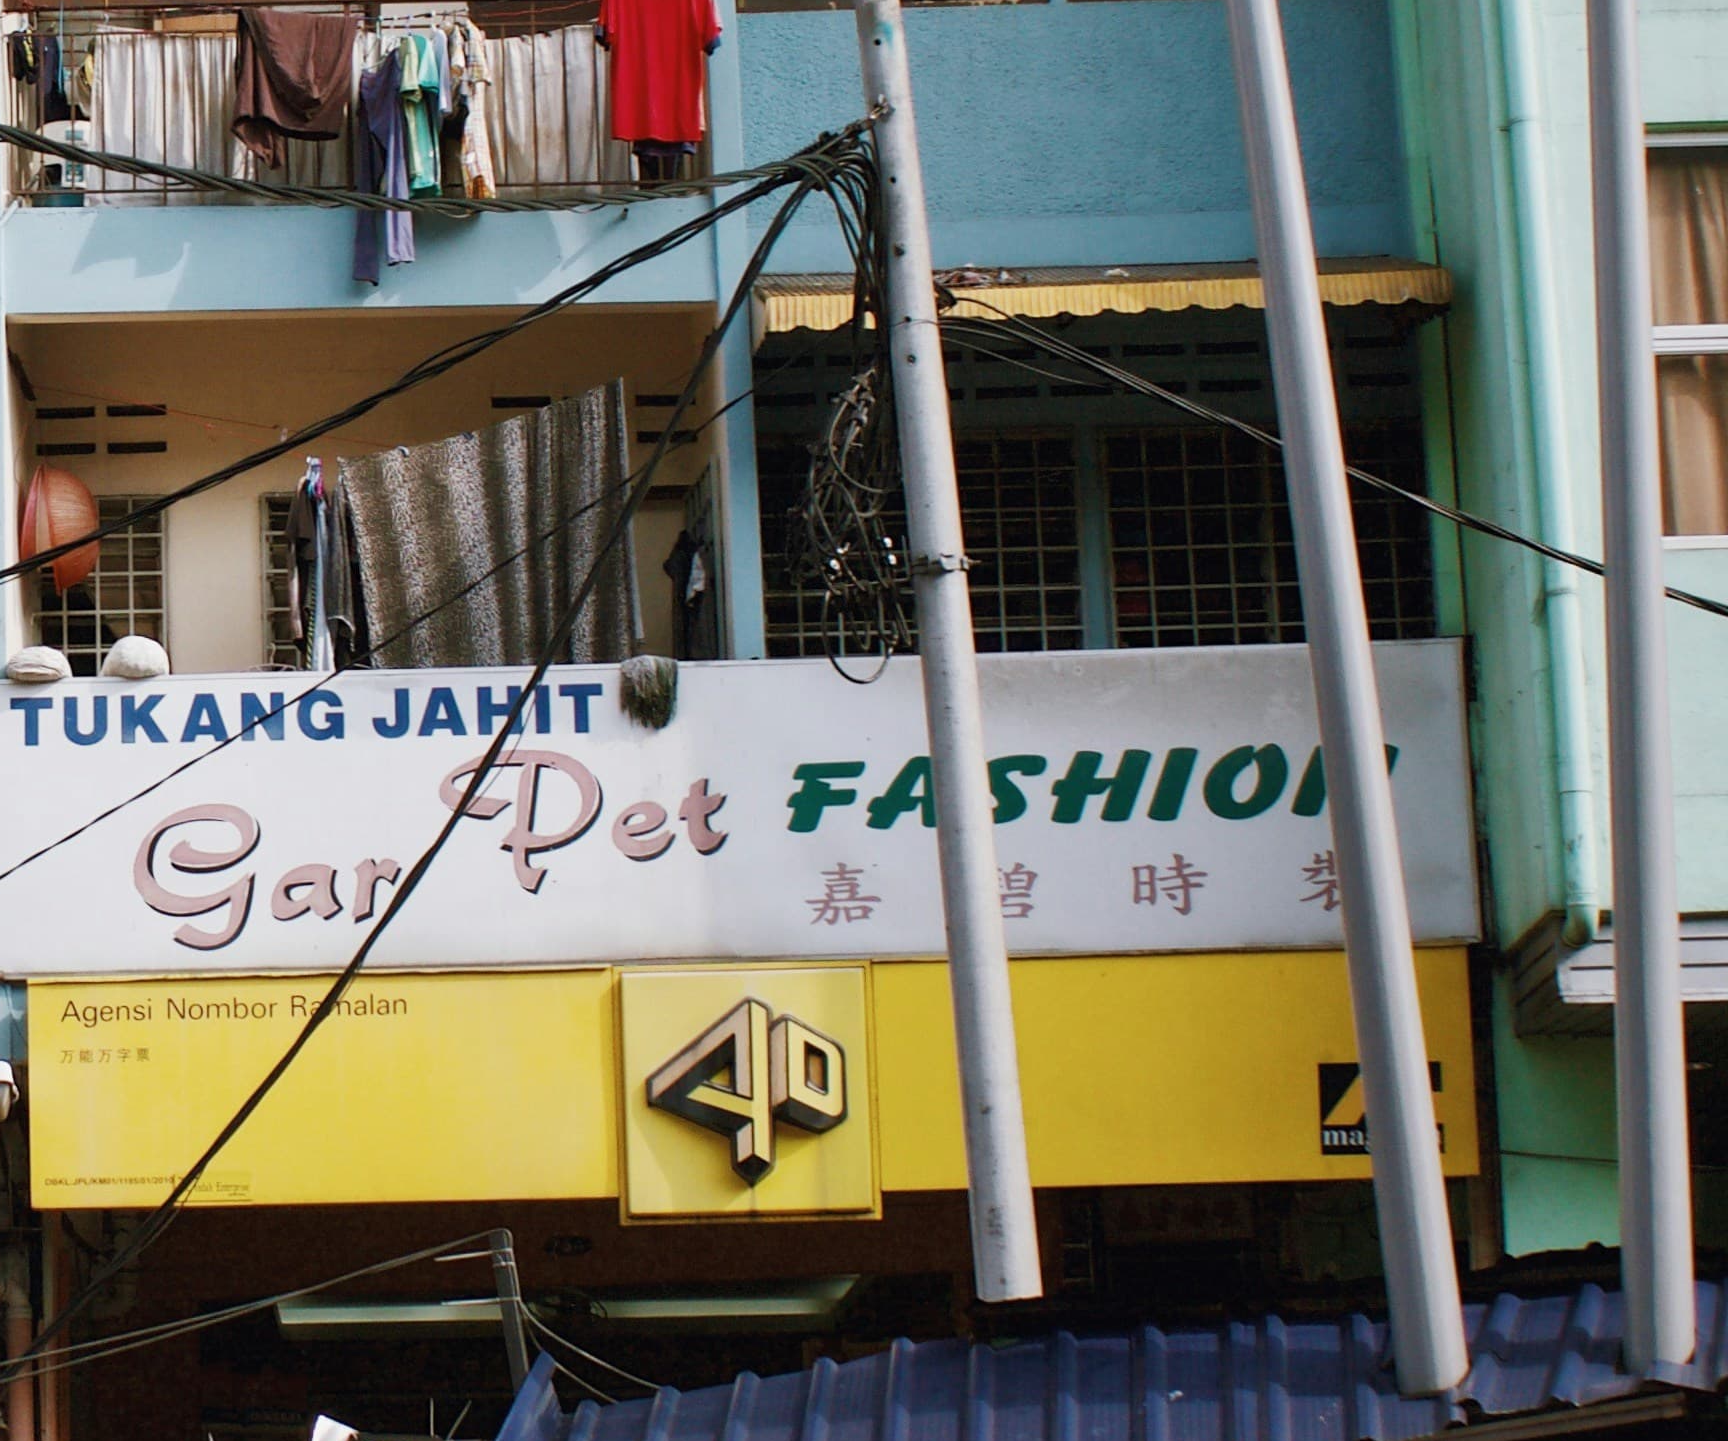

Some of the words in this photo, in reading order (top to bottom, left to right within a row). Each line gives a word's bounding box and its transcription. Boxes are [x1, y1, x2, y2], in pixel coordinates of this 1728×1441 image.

[9, 689, 345, 746] TUKANG
[372, 682, 603, 738] JAHIT
[60, 997, 153, 1028] Agensi
[166, 996, 278, 1020] Nombor
